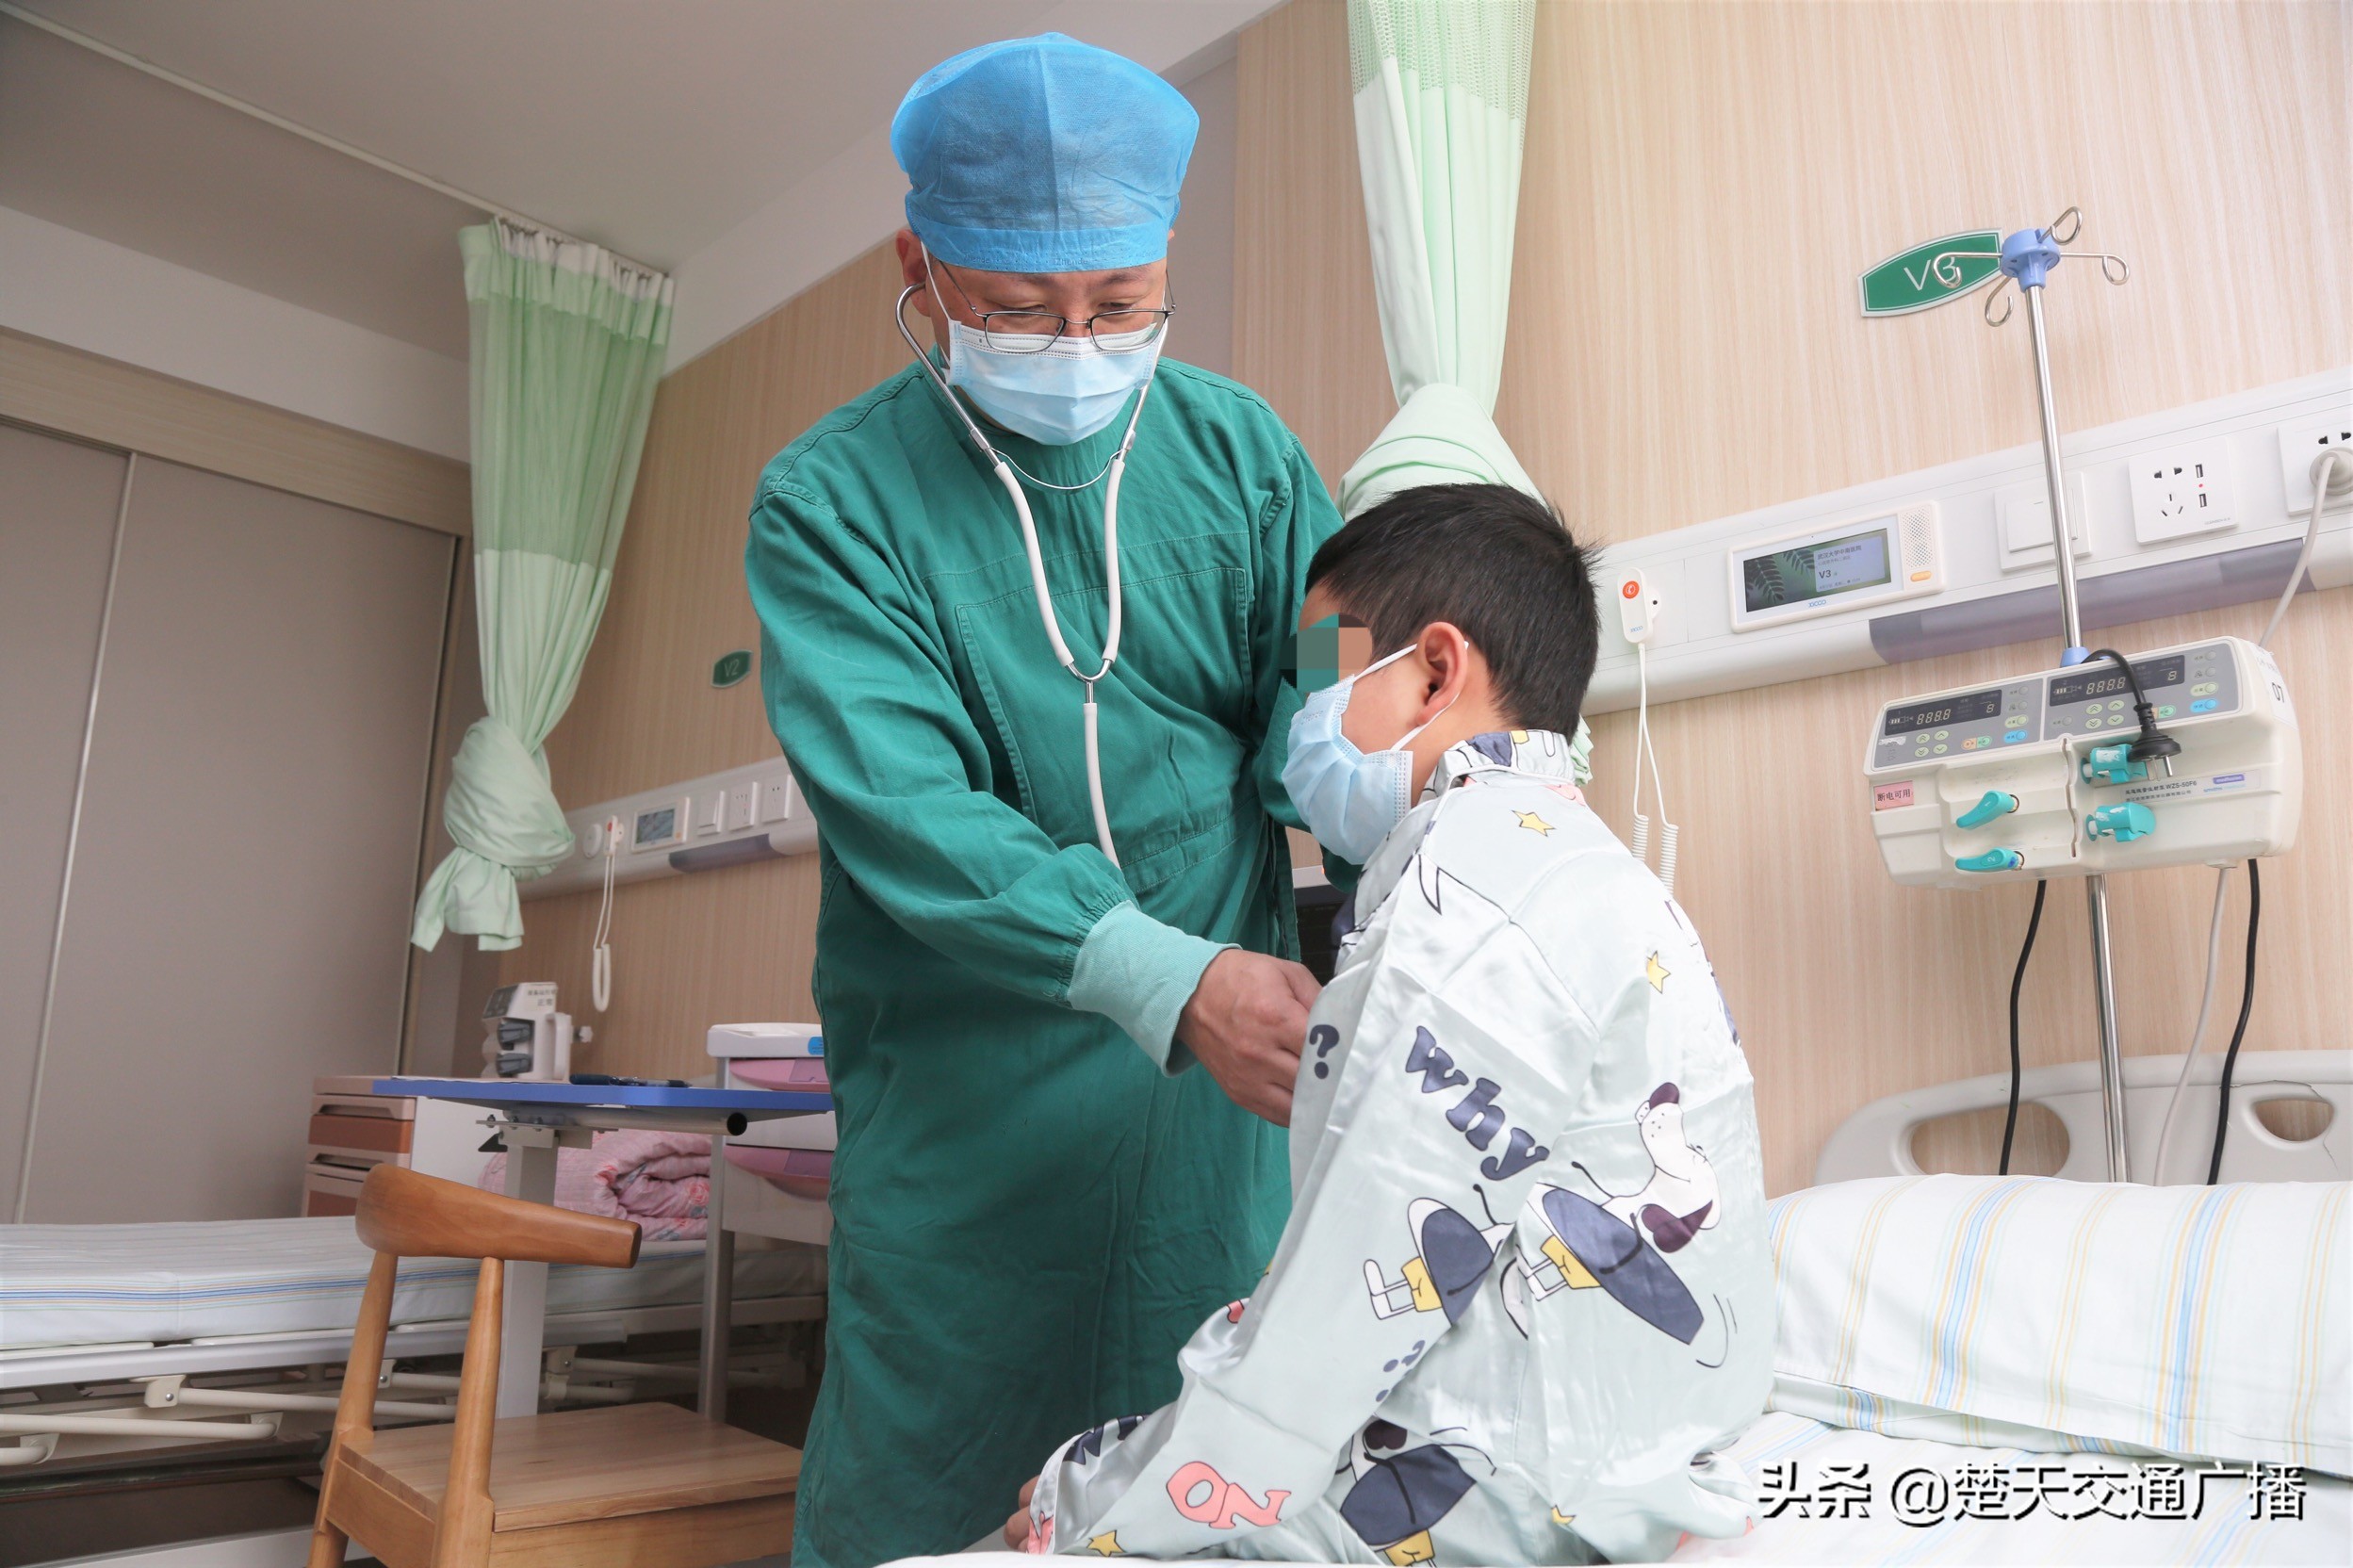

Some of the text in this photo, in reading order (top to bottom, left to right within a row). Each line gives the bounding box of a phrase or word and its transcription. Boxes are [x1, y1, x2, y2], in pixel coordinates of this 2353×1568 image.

[1819, 569, 1832, 579] V3
[724, 659, 740, 678] V2
[2165, 780, 2198, 790] WZS-50F6
[1877, 788, 1911, 802] 断电可用
[1405, 1025, 1550, 1181] why
